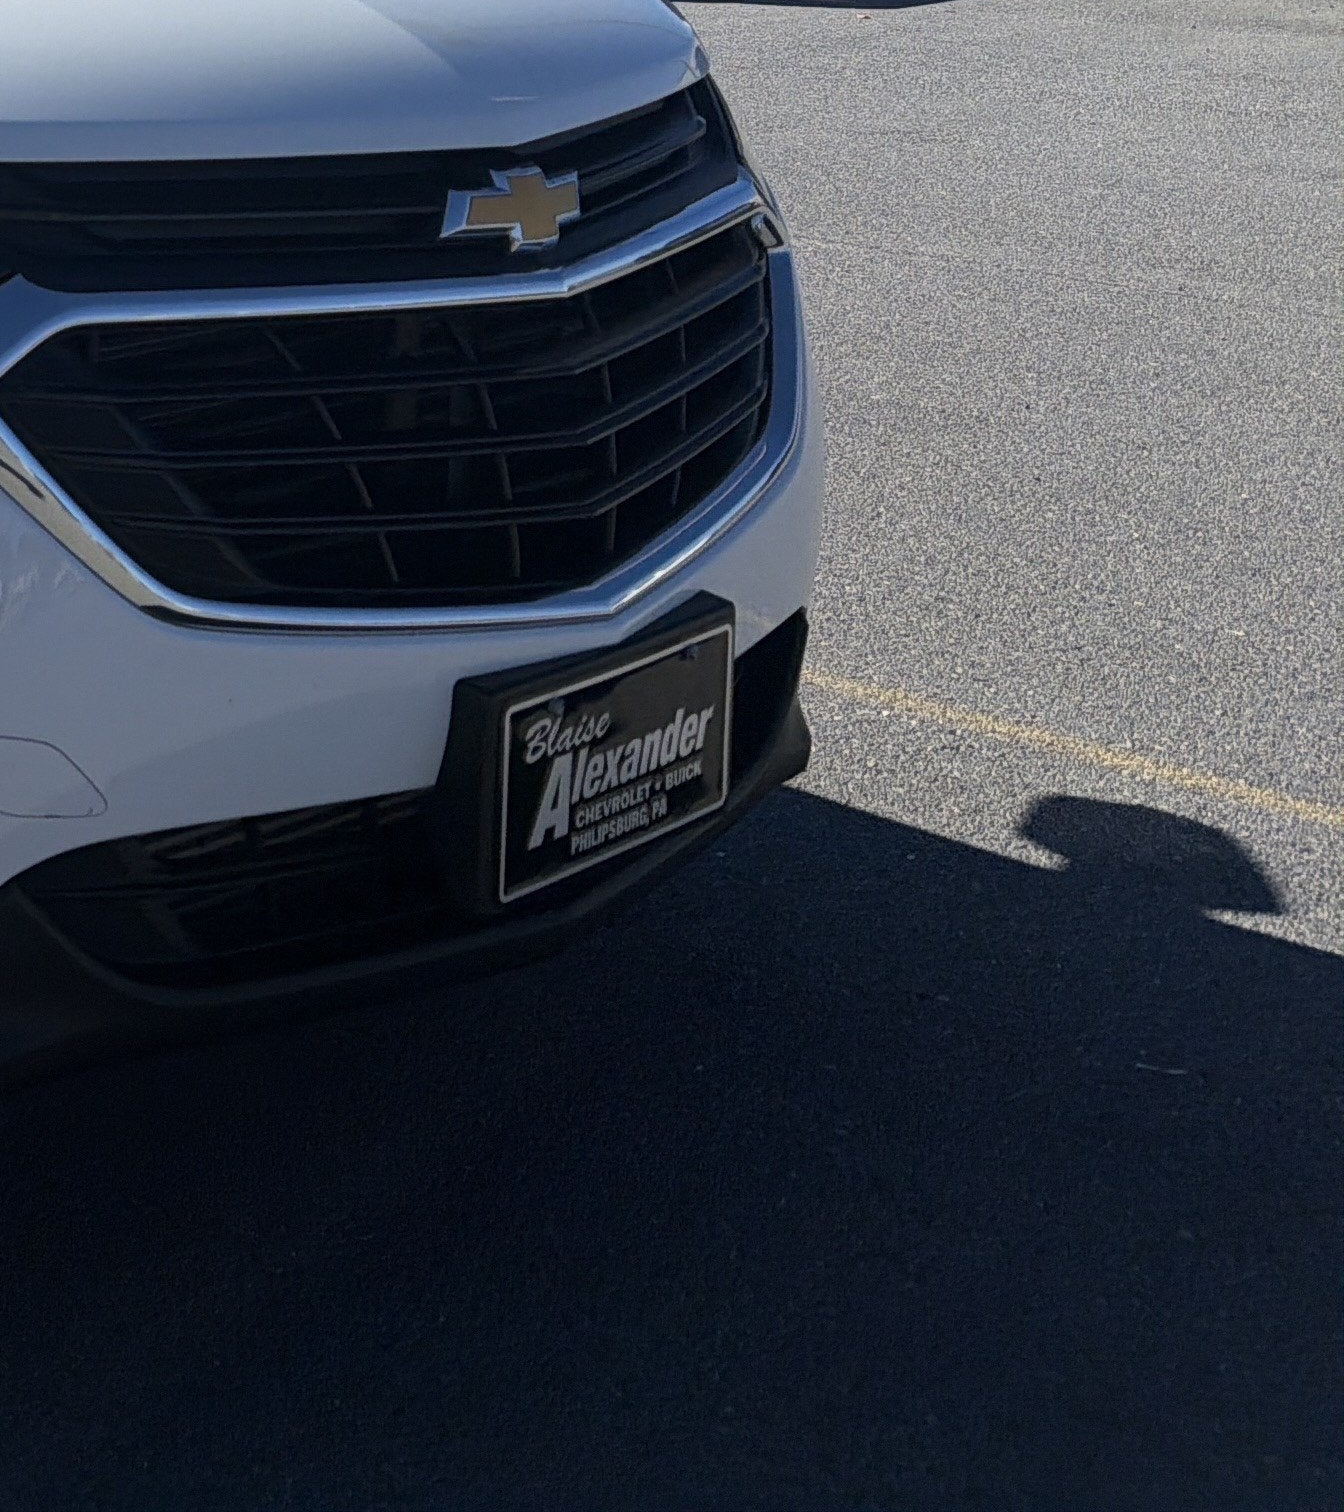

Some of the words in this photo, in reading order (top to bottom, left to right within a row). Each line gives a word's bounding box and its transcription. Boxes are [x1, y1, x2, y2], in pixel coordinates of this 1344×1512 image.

[525, 711, 611, 765] Blaise
[527, 705, 714, 851] Alexander
[575, 780, 652, 828] CHEVROLET
[665, 759, 703, 791] BUICK
[650, 793, 668, 821] PA
